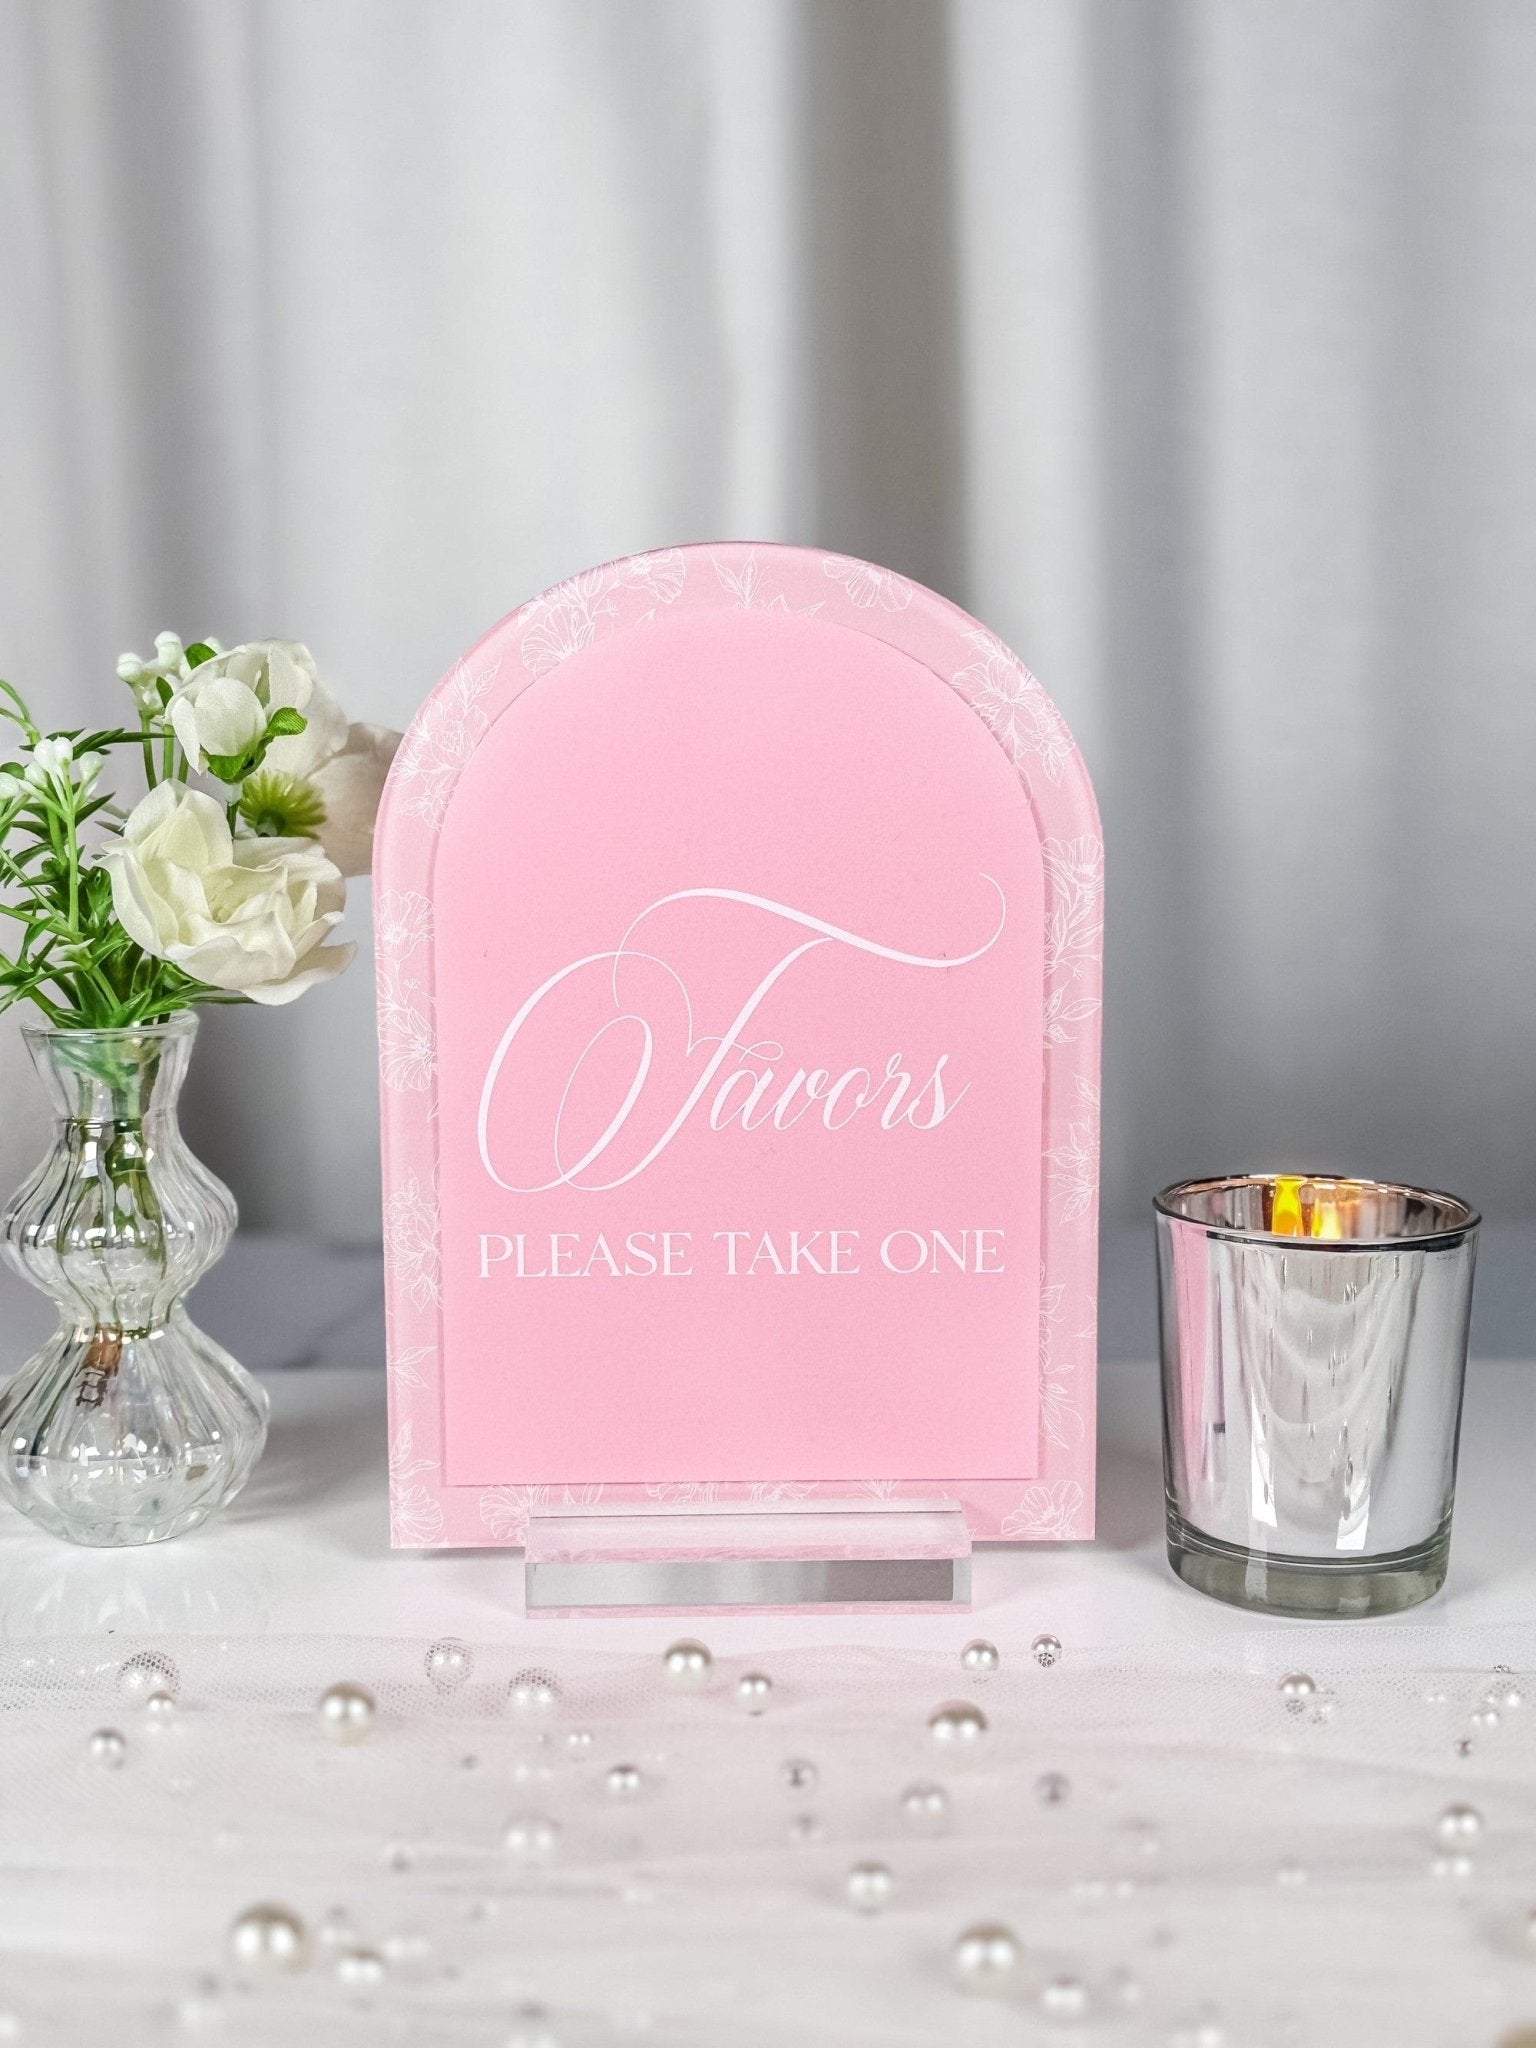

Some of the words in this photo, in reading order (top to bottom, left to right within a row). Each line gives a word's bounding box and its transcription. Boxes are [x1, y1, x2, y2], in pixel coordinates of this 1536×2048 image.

[477, 872, 1006, 1193] Favors
[479, 1232, 693, 1278] PLEASE
[713, 1231, 860, 1275] TAKE
[880, 1229, 1005, 1274] ONE
